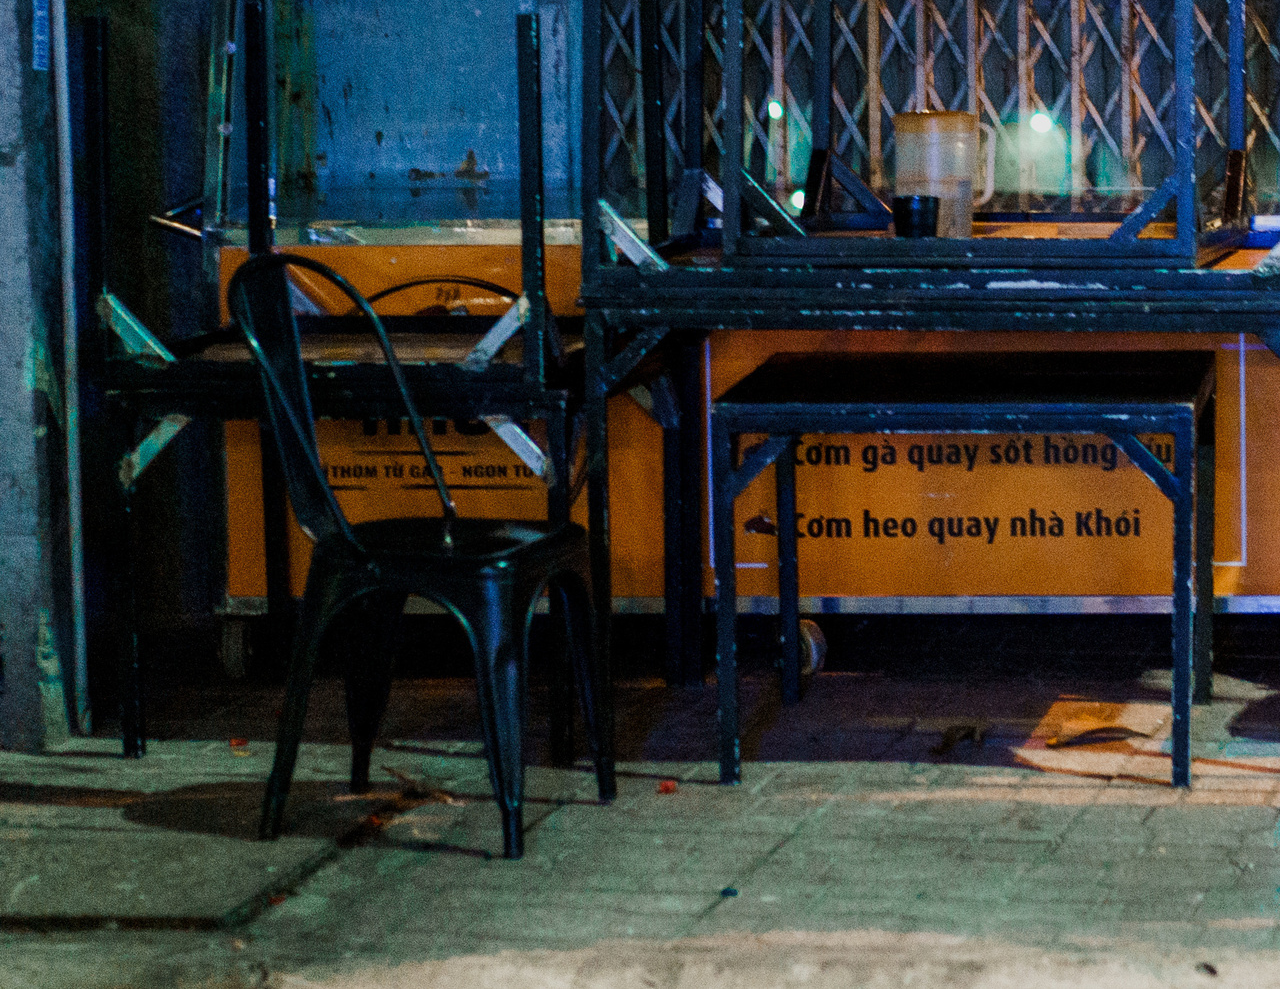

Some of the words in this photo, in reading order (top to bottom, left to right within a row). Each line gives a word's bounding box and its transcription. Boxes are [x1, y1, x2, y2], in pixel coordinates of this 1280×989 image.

[862, 438, 897, 472] gà
[907, 443, 978, 472] quay
[1044, 435, 1118, 471] hồng
[863, 509, 917, 538] heo
[928, 516, 999, 544] quay
[1010, 509, 1064, 537] nhà
